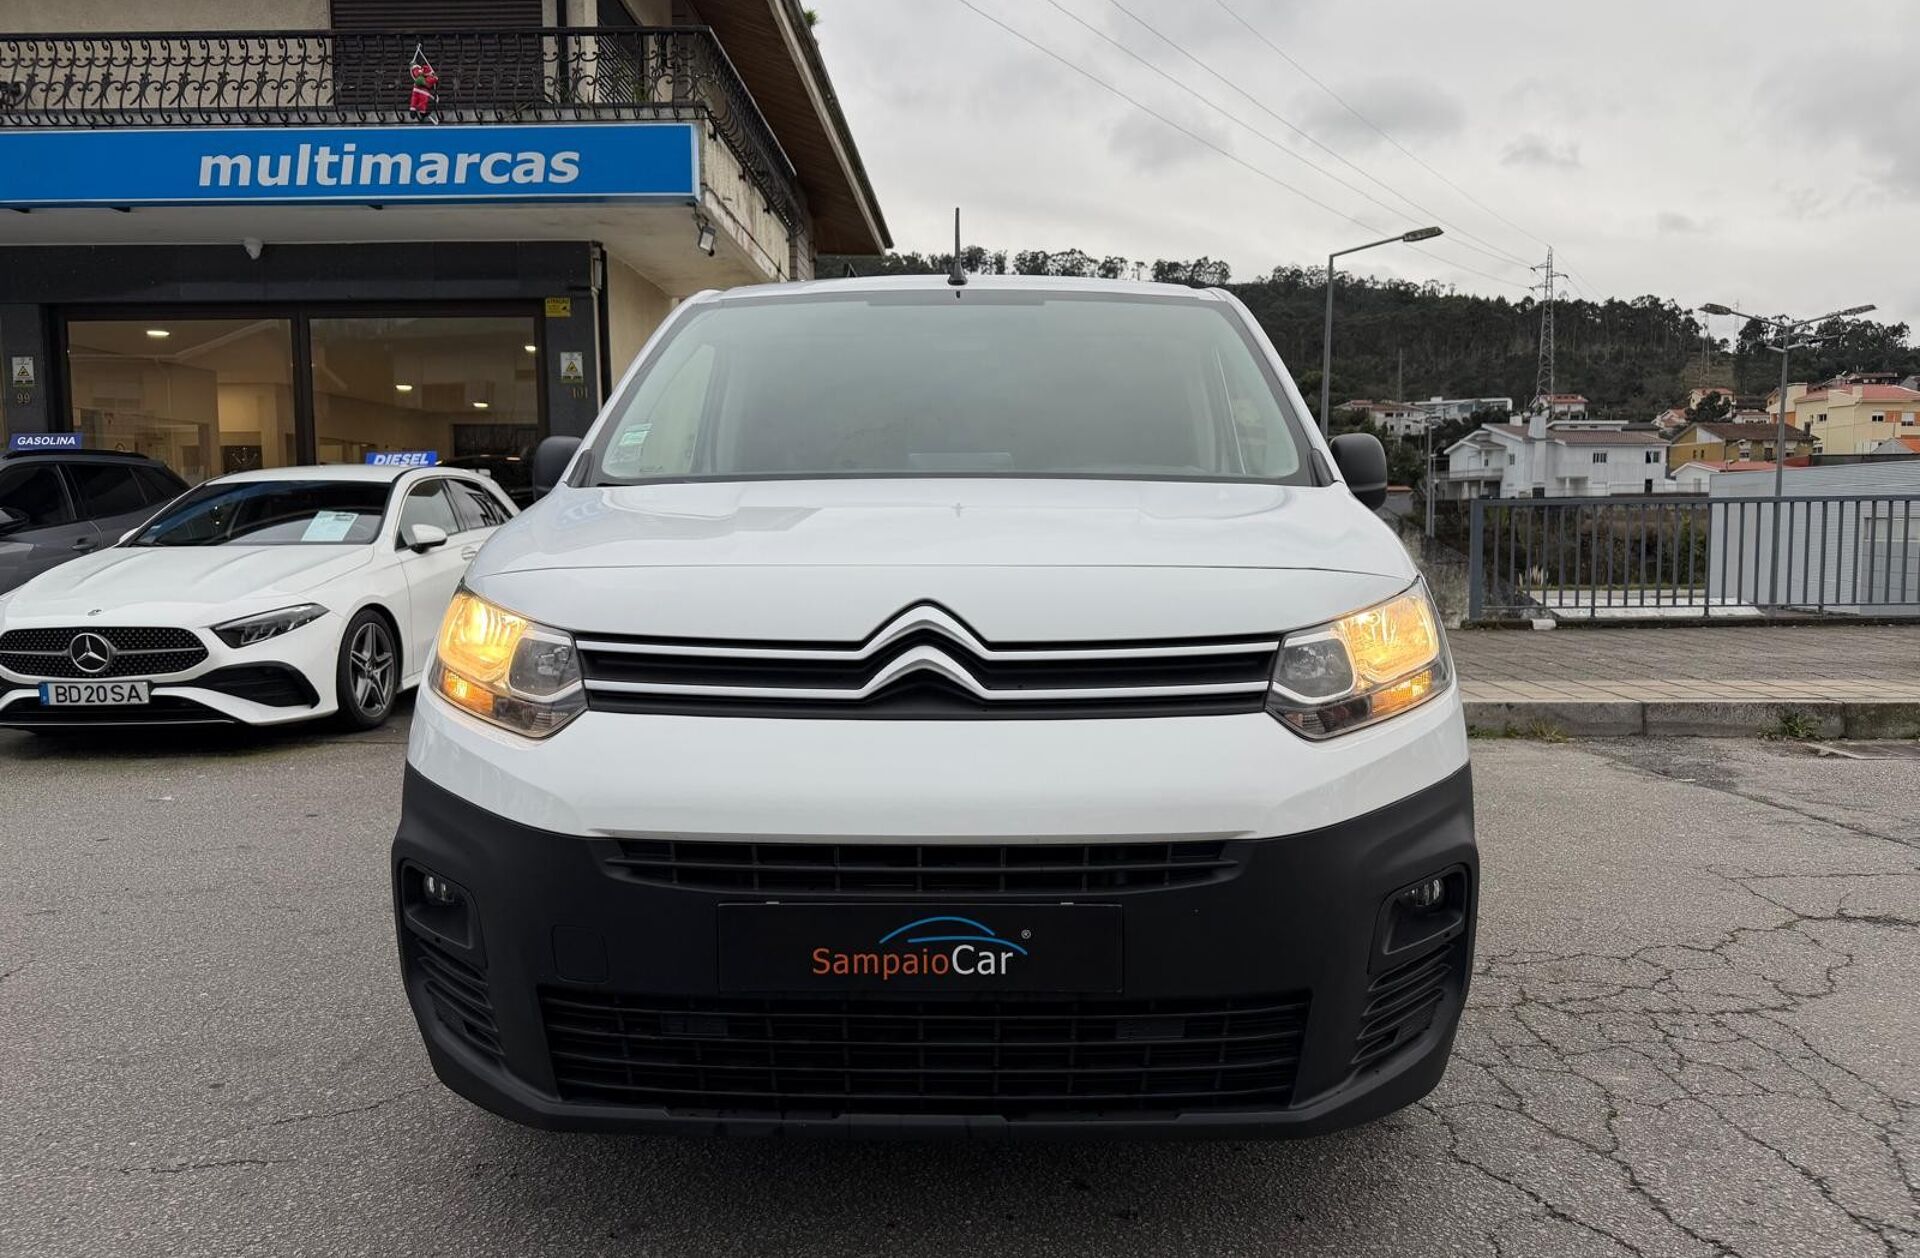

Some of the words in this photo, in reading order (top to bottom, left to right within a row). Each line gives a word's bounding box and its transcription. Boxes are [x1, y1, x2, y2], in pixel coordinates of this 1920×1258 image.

[199, 143, 581, 187] multimarcas
[17, 436, 76, 446] GASOLINA
[374, 453, 429, 466] DIESEL
[813, 944, 1014, 980] SampaioCar
